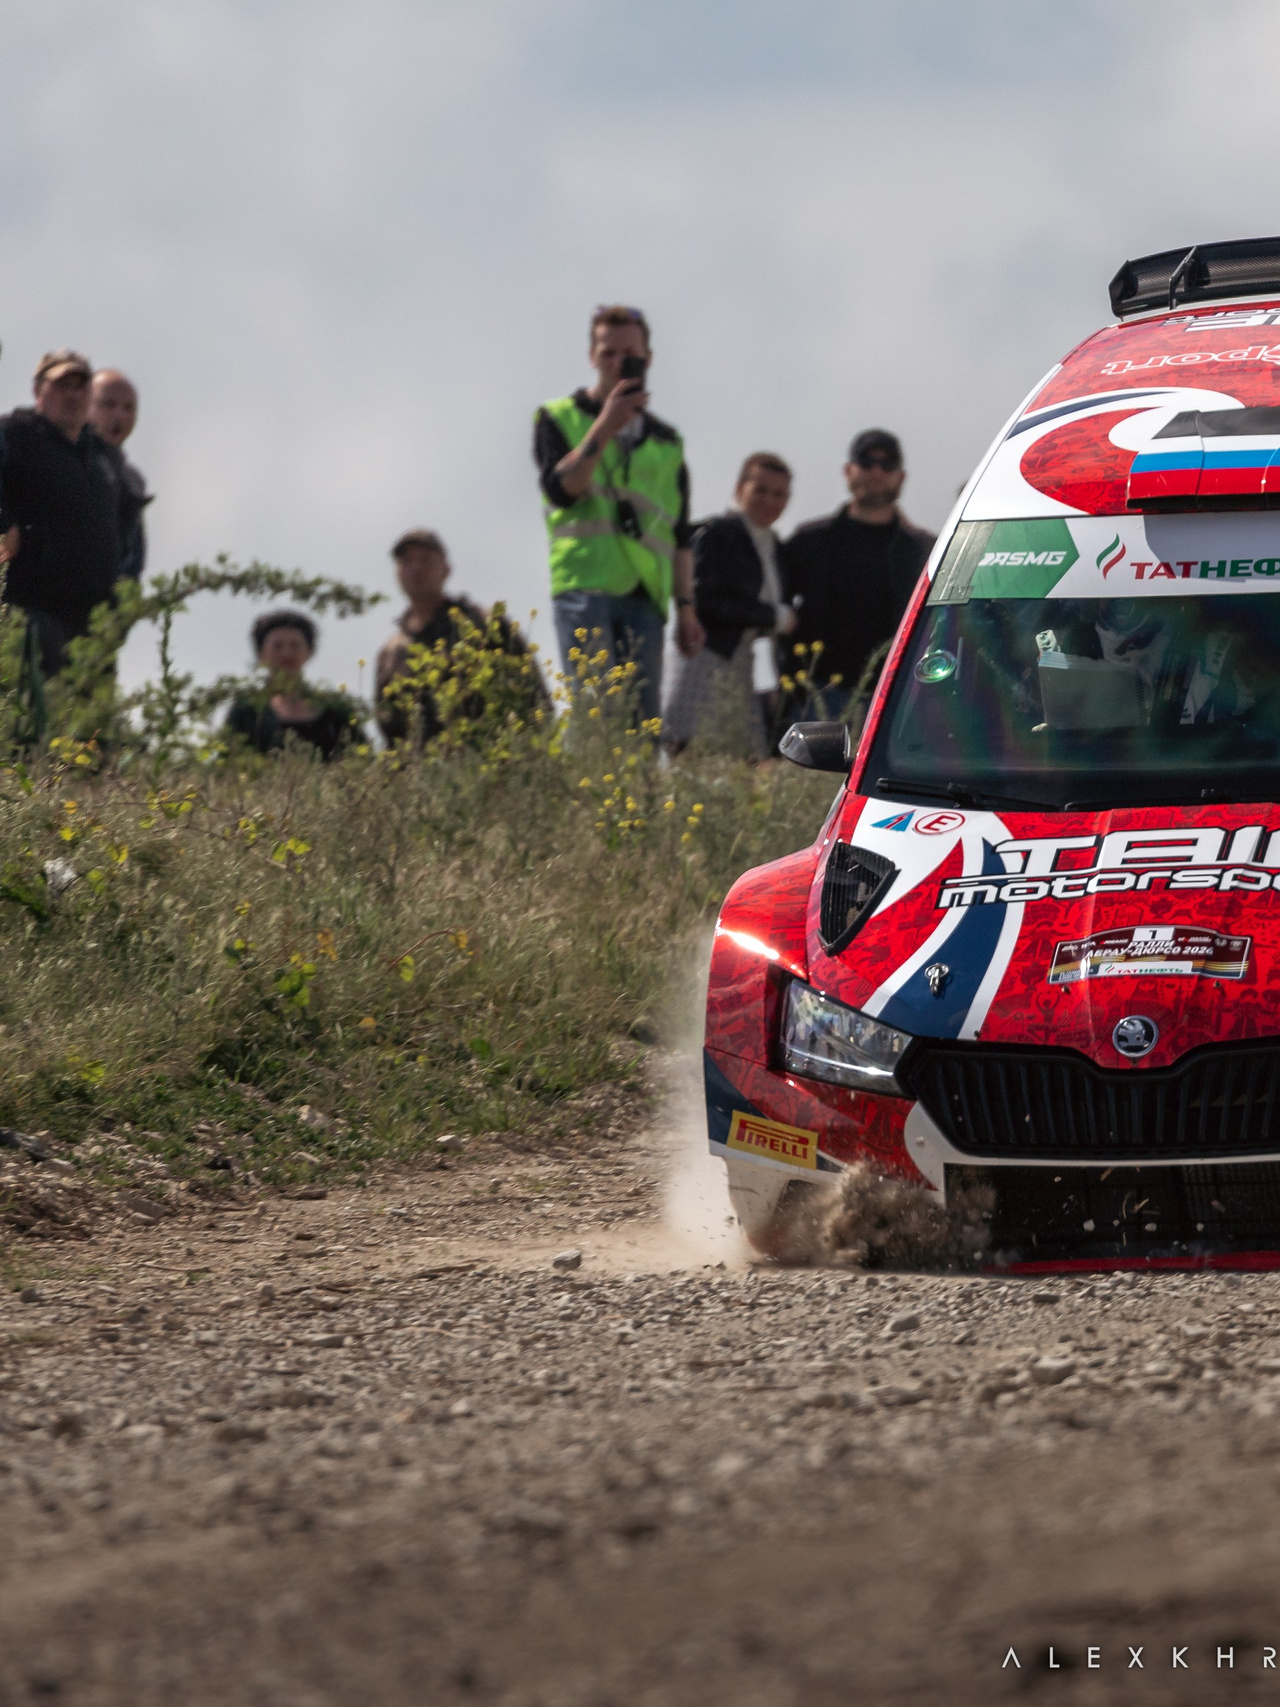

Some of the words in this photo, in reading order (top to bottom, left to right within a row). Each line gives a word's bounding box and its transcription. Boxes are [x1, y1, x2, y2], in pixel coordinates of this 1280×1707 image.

[922, 815, 958, 831] E
[1149, 929, 1157, 939] 1
[1127, 940, 1176, 949] РАЛЛИ
[735, 1118, 809, 1160] PIRELLI
